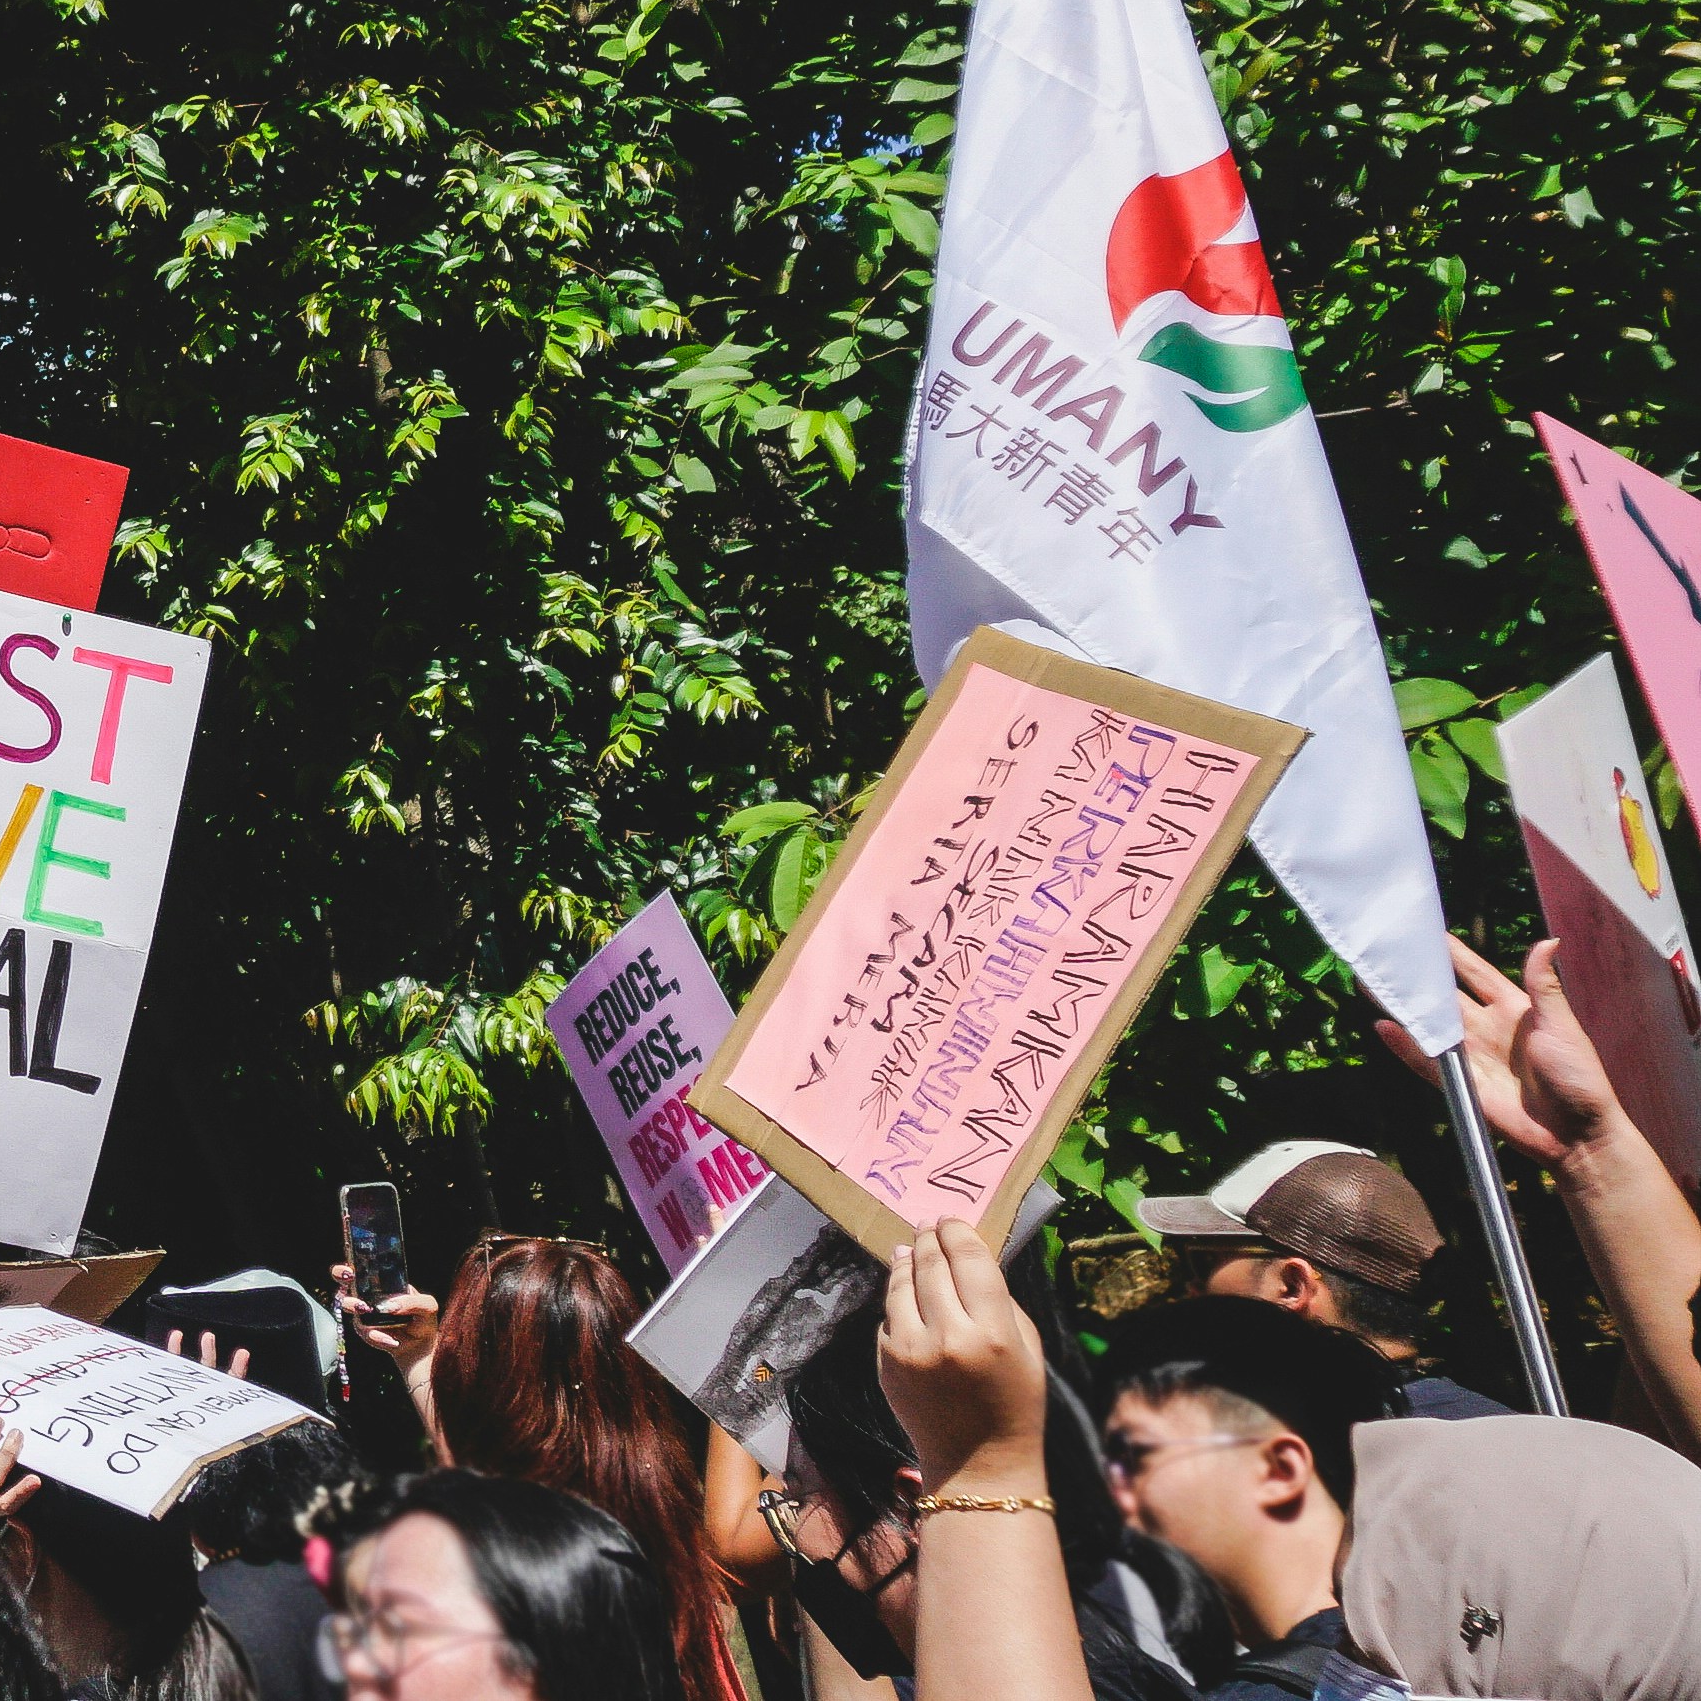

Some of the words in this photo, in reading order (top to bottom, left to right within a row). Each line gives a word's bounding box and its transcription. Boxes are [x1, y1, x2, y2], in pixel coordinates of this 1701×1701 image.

[923, 370, 1163, 564] 馬大新青年
[952, 300, 1226, 536] UMANY
[910, 713, 1039, 887] SERTA
[573, 946, 682, 1067] REDUCE,
[794, 911, 916, 1092] MERTA
[865, 723, 1179, 1201] PERKAHWINAN
[870, 838, 1001, 1035] SECARA
[928, 750, 1241, 1204] HARAMKAN
[607, 1013, 704, 1121] REUSE,
[30, 1364, 221, 1448] ANYTHING
[106, 1432, 159, 1475] DO
